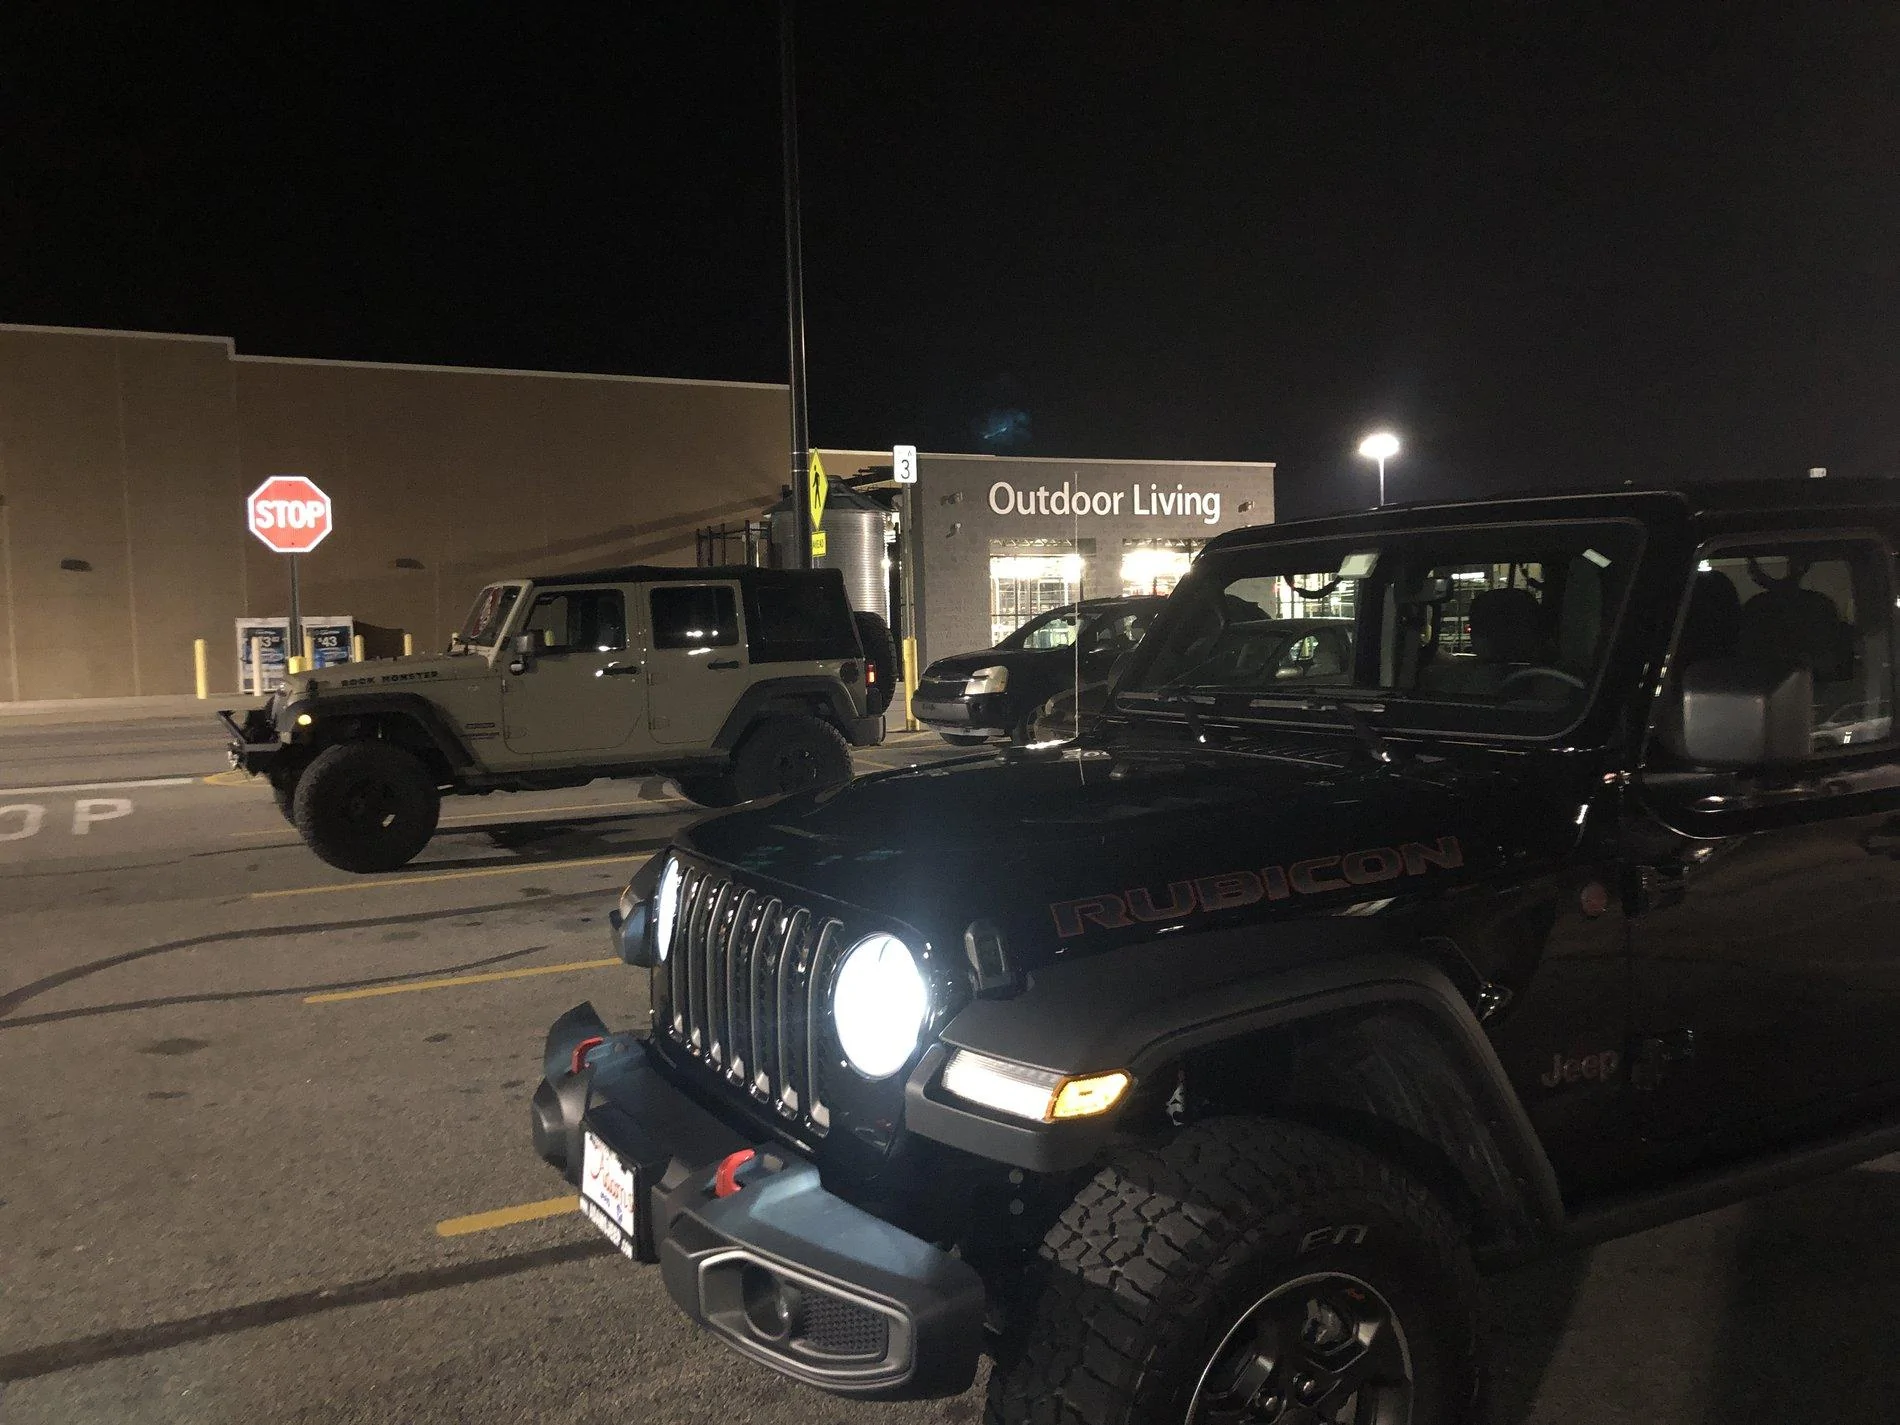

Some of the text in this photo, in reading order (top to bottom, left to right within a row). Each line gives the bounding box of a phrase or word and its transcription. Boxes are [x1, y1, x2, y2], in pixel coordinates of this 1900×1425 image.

[900, 459, 911, 480] 3
[255, 500, 325, 529] STOP
[989, 481, 1221, 524] Outdoor Living
[381, 671, 438, 682] MONSTER
[1049, 836, 1466, 938] RUBICON
[1541, 1050, 1619, 1088] Jeep
